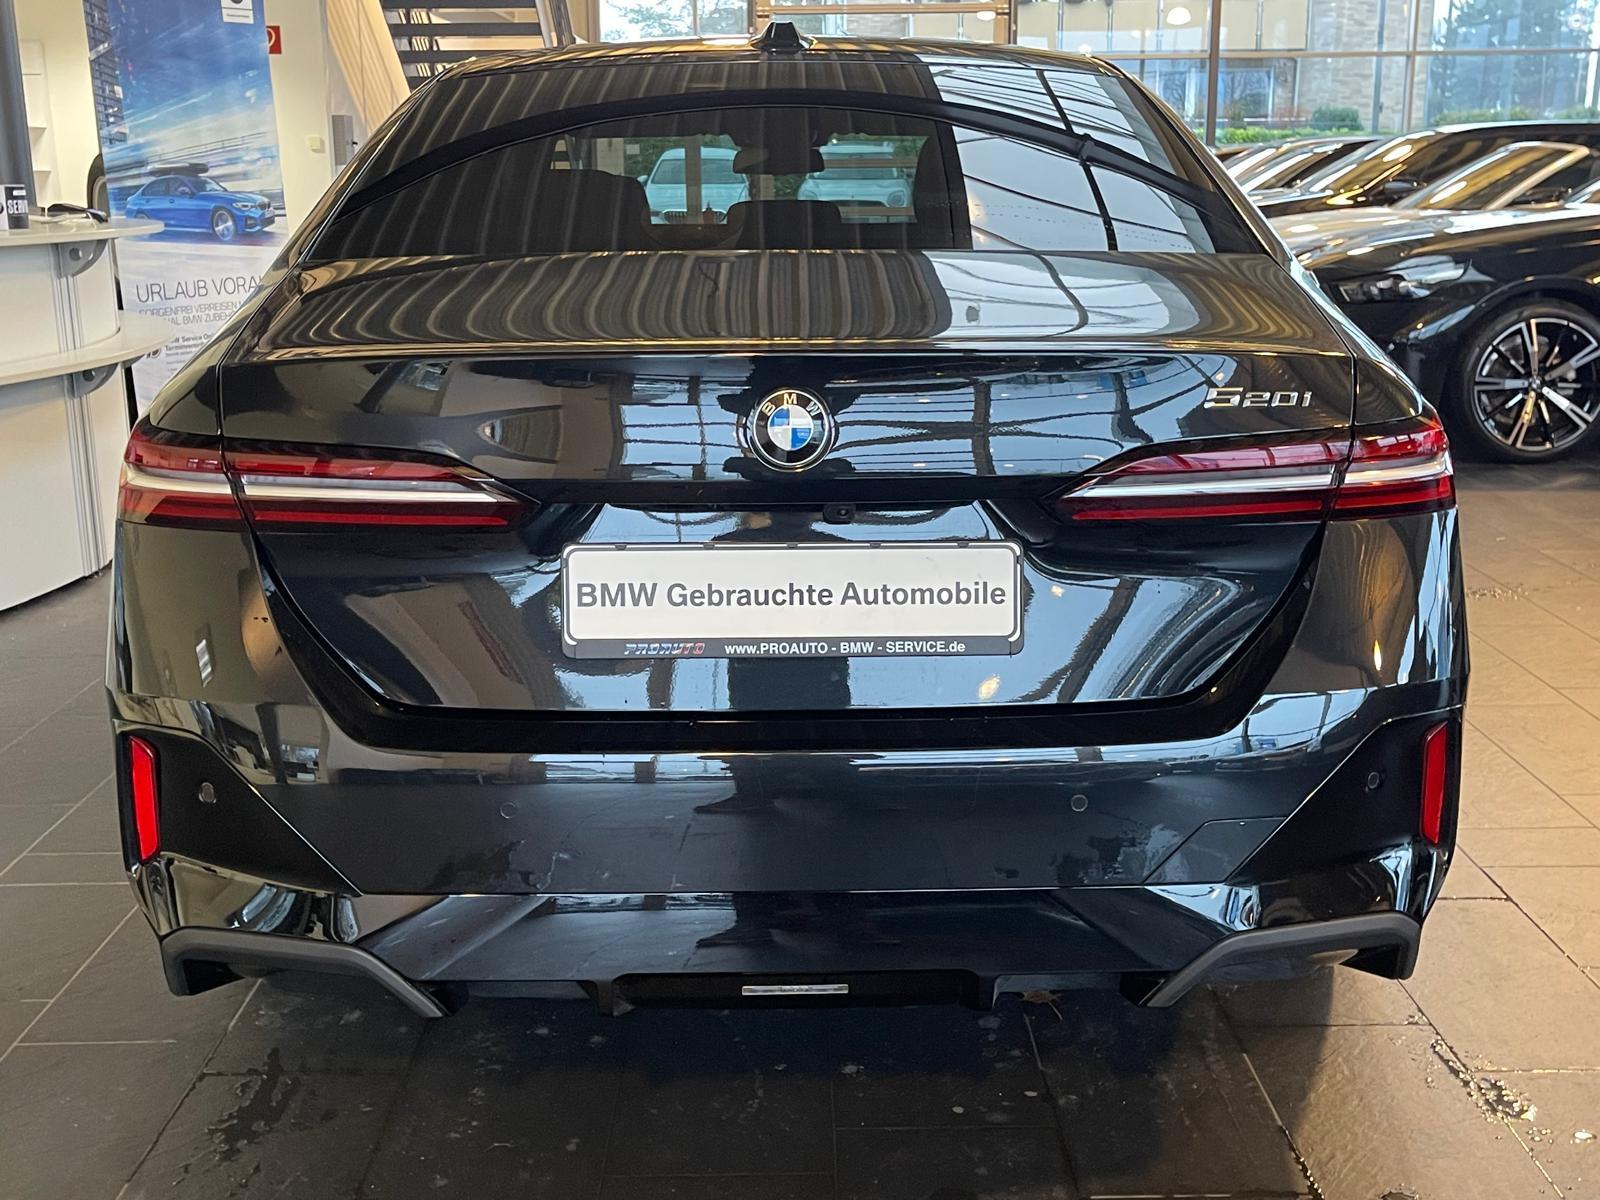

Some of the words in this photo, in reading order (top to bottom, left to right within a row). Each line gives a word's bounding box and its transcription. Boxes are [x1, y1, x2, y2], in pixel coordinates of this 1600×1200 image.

[136, 280, 208, 303] URLAUB
[212, 275, 262, 296] VORA
[761, 393, 821, 417] BMW
[1203, 387, 1312, 409] 520i
[577, 582, 658, 607] BMW
[667, 582, 833, 607] Gebrauchte
[840, 581, 1006, 606] Automobile
[624, 642, 706, 655] PROAUTO
[725, 642, 828, 655] www.PROAUTO
[840, 641, 874, 654] BMW
[886, 640, 966, 654] SERVICE.de
